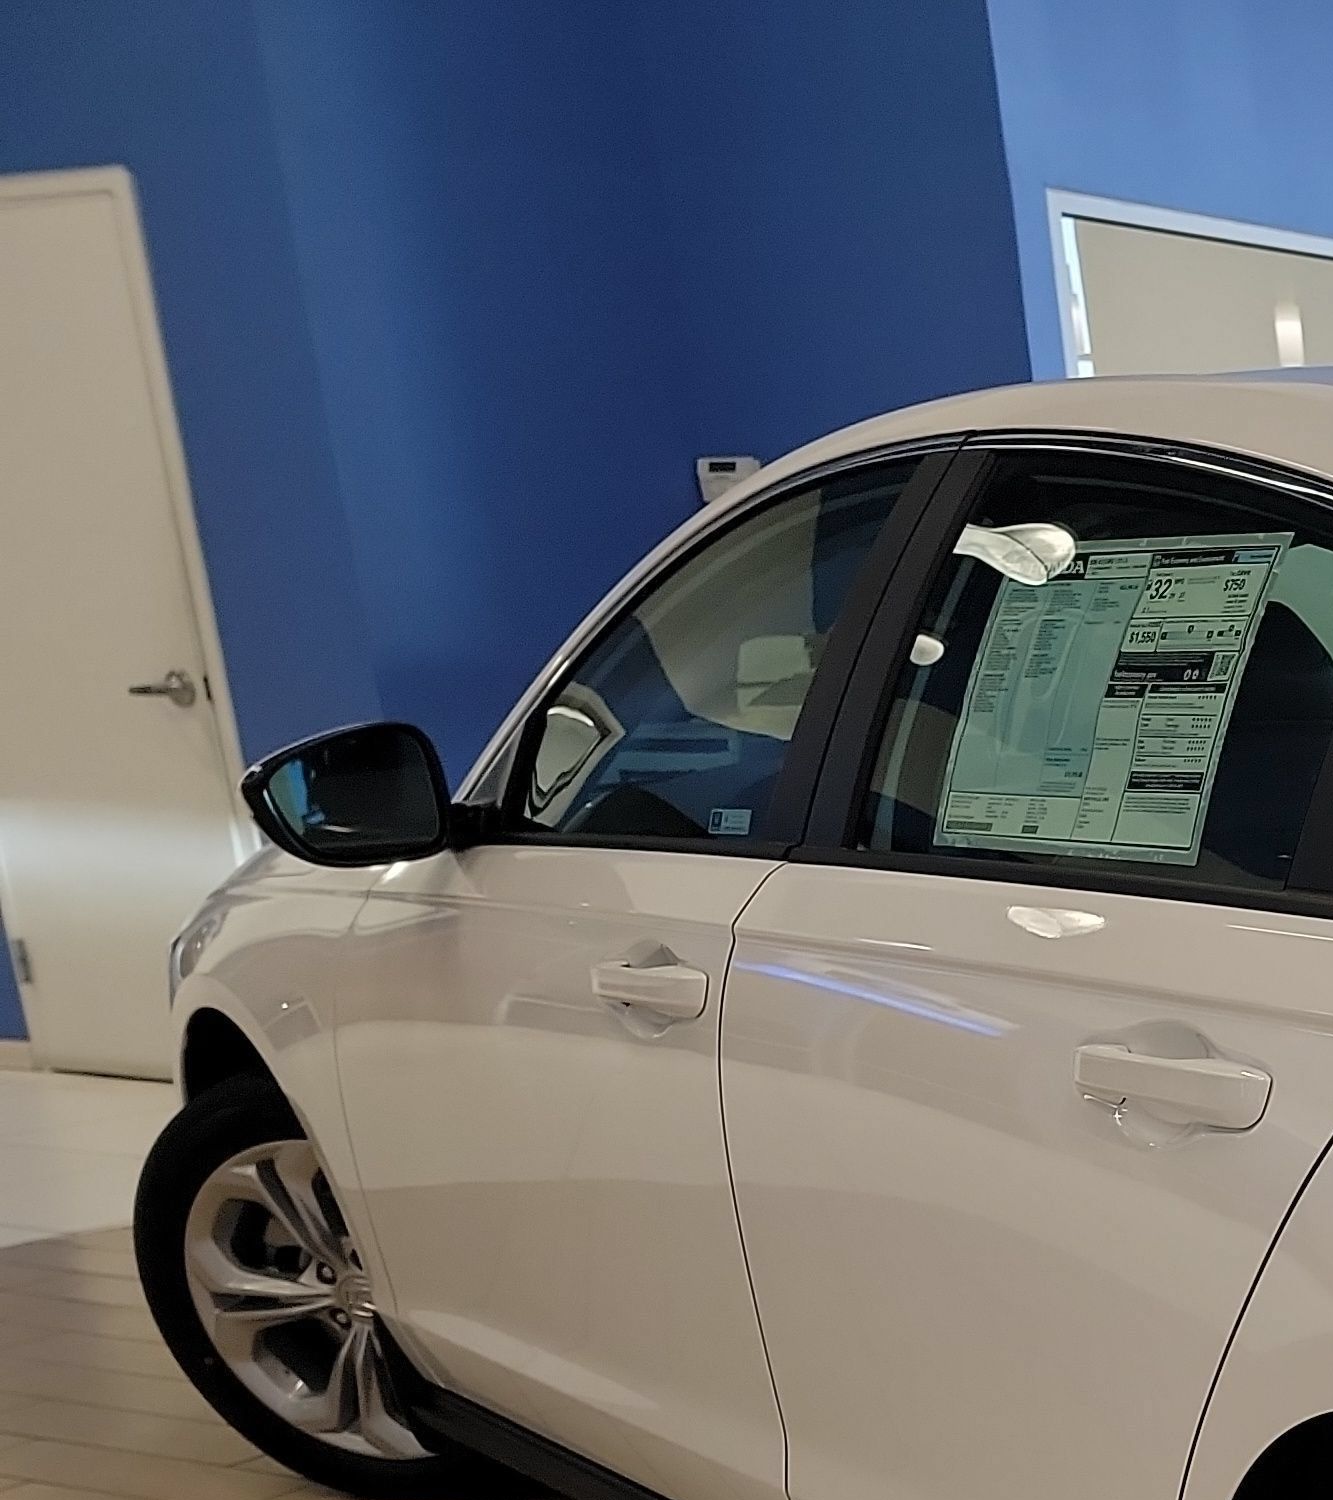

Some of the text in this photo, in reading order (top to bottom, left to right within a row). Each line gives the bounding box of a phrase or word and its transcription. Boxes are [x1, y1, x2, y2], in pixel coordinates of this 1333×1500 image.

[1149, 578, 1173, 600] 32
[1223, 578, 1246, 592] $750
[1128, 631, 1157, 644] $1,550
